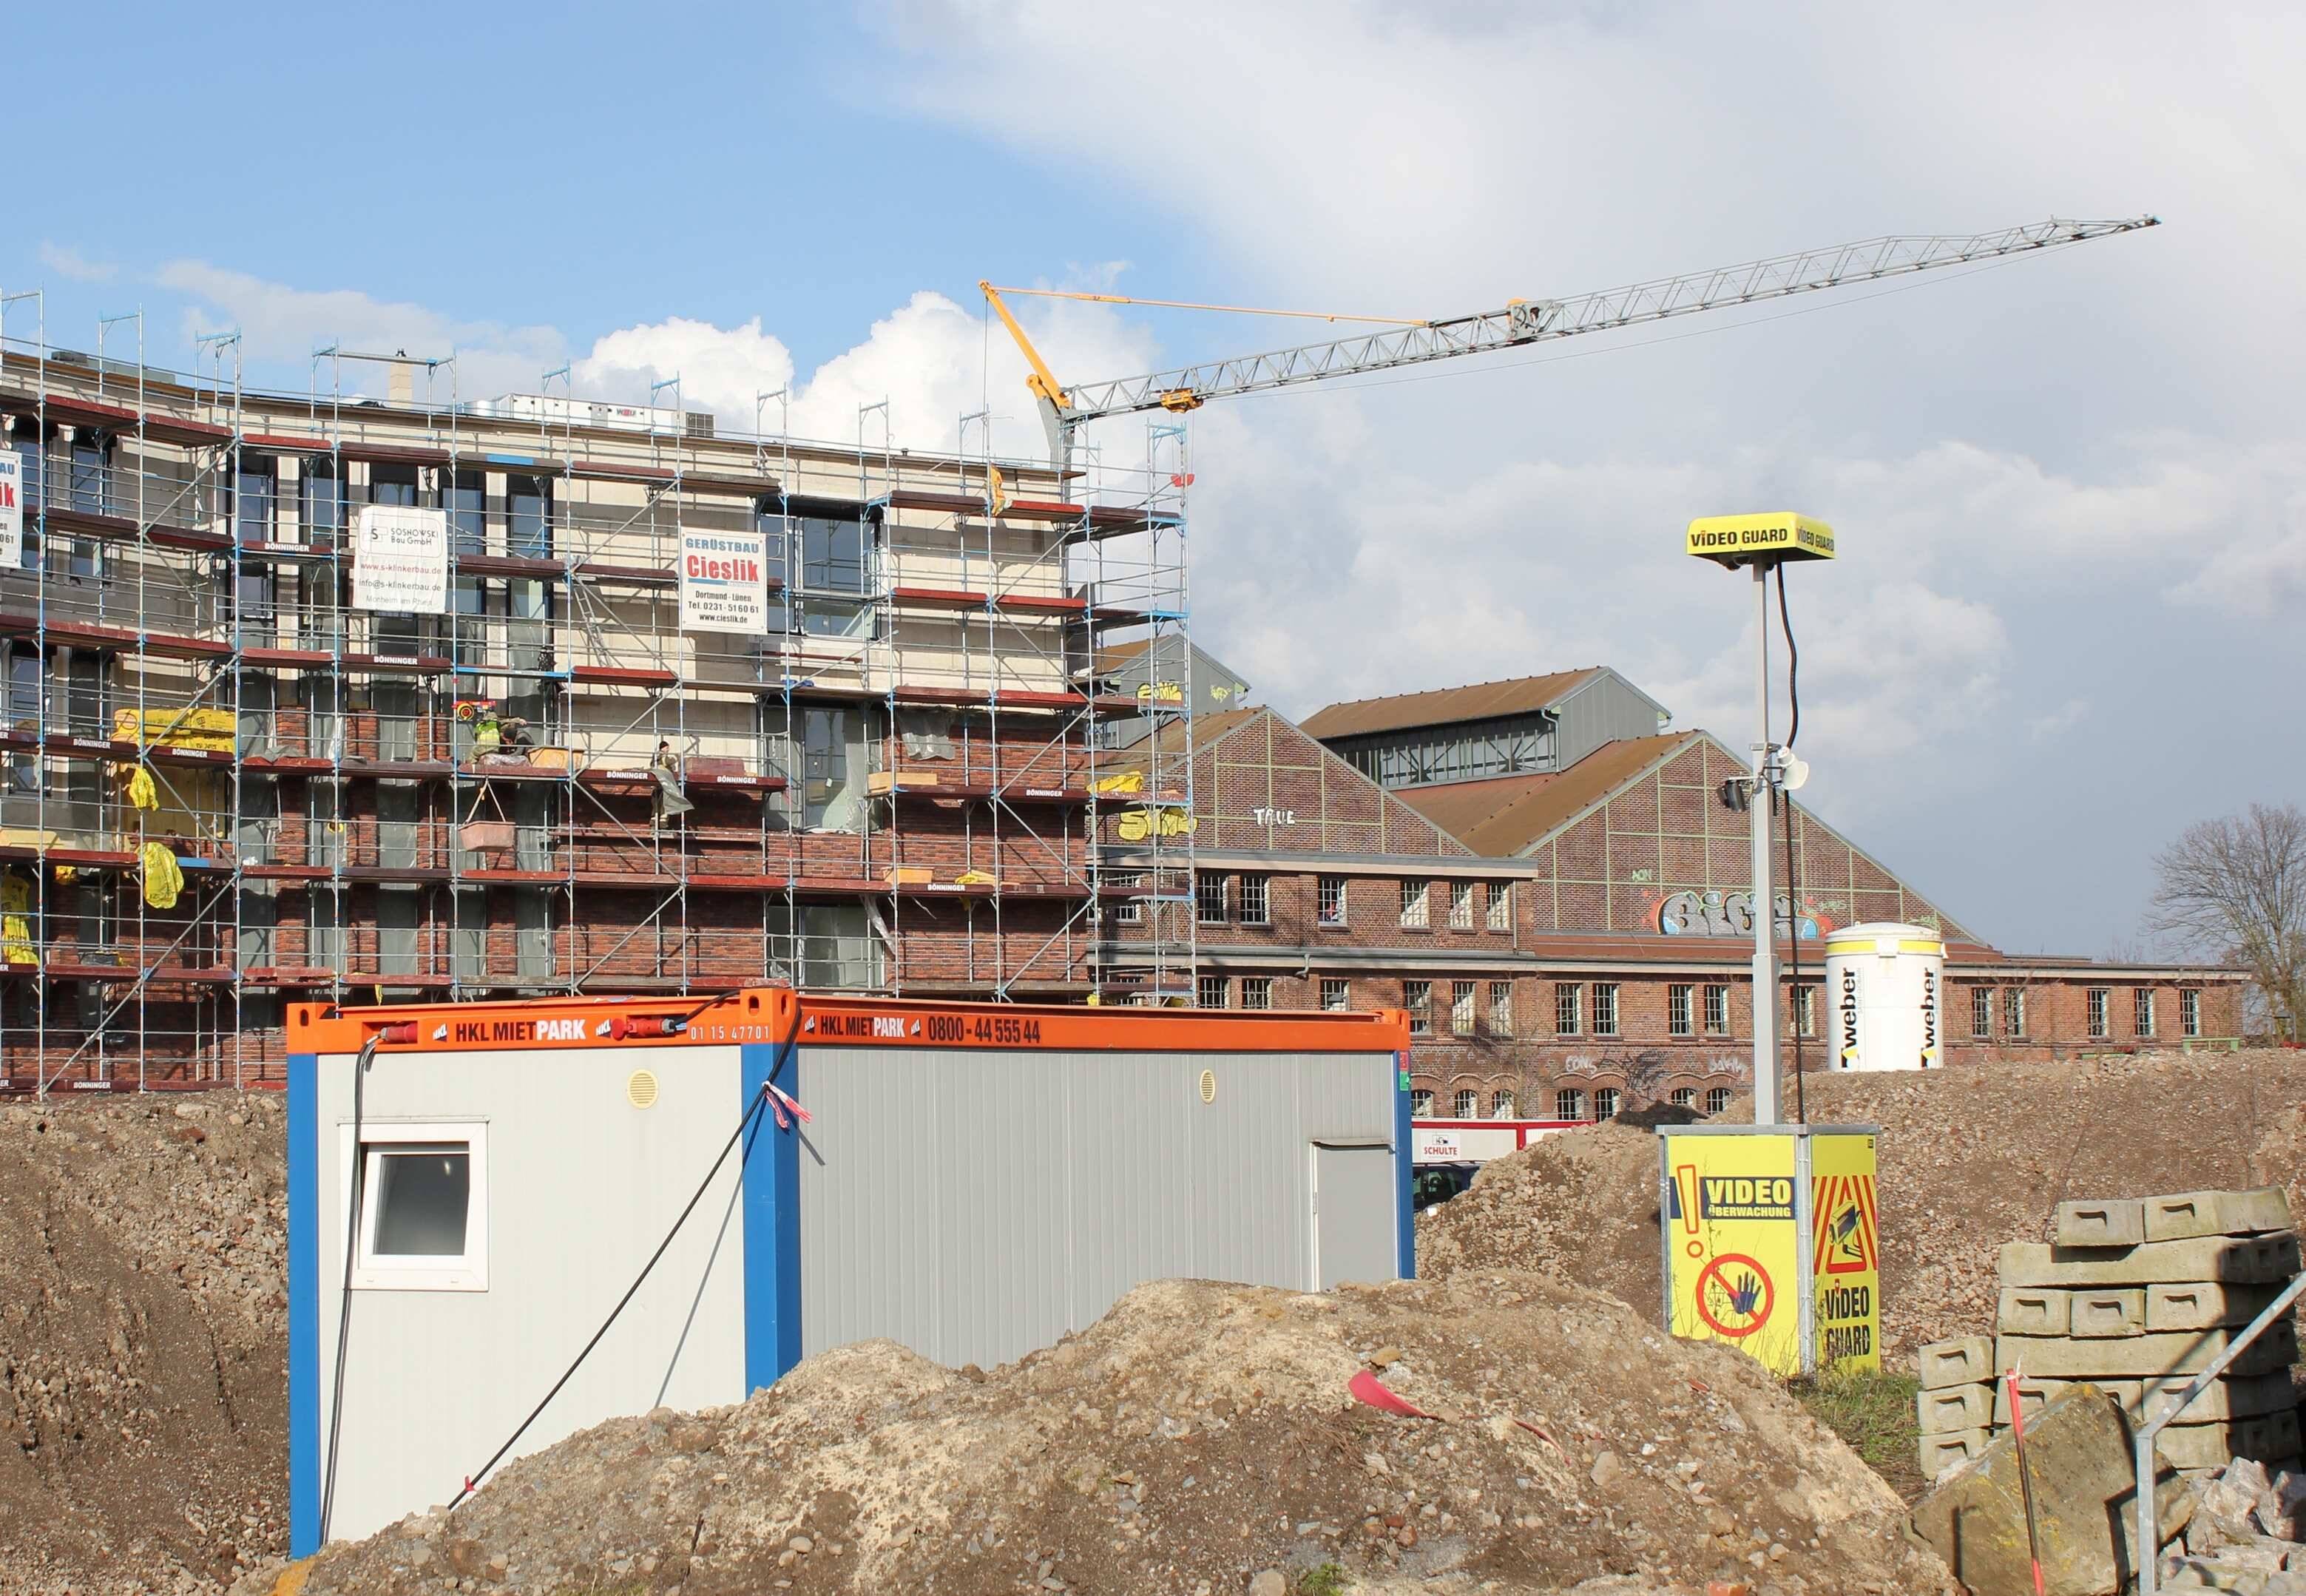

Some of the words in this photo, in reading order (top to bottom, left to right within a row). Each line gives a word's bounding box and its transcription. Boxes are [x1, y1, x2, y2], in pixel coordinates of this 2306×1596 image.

[391, 536, 405, 544] Bau
[407, 537, 432, 545] GmbH
[1742, 528, 1788, 544] GUARD
[265, 543, 309, 552] BÖNNINGER
[686, 538, 759, 553] GERÜSTBAU
[1815, 535, 1834, 552] GUARD
[360, 563, 442, 575] www.s-klinkerbau.de
[687, 555, 759, 581] Cieslik
[359, 579, 442, 592] info@s-klinkerbau.de
[695, 590, 727, 601] Dortmund
[732, 593, 751, 602] Lünen
[688, 601, 702, 609] Tel.
[703, 602, 723, 611] 0231
[699, 614, 748, 623] www.cieslik.de
[373, 656, 418, 665] BÖNNINGER
[73, 738, 111, 749] BÖNNINGER
[172, 748, 207, 757] BÖNNINGER
[606, 771, 648, 780] BÖNNINGER
[717, 775, 757, 784] BÖNNINGER
[1027, 788, 1063, 797] BÖNNINGER
[1251, 806, 1295, 825] TRUE
[927, 884, 965, 892] BÖNNINGER
[1840, 967, 1857, 1048] weber
[1921, 967, 1935, 1048] weber
[456, 1023, 490, 1042] HKL
[493, 1019, 586, 1042] MIETPARK
[595, 1018, 611, 1036] HKL
[691, 1027, 703, 1040] 01
[711, 1026, 724, 1039] 15
[731, 1026, 769, 1040] 47701
[821, 1015, 843, 1035] HKL
[845, 1016, 905, 1038] MIETPARK
[928, 1016, 964, 1041] 0800
[975, 1018, 993, 1042] 44
[995, 1019, 1020, 1043] 555
[1023, 1020, 1041, 1044] 44
[73, 1081, 110, 1089] BÖNNINGER
[1424, 1147, 1458, 1156] SCHULTE
[1705, 1179, 1791, 1205] VIDEO
[1708, 1204, 1791, 1217] ÜBERWACHUNG
[1827, 1325, 1870, 1357] GUARD
